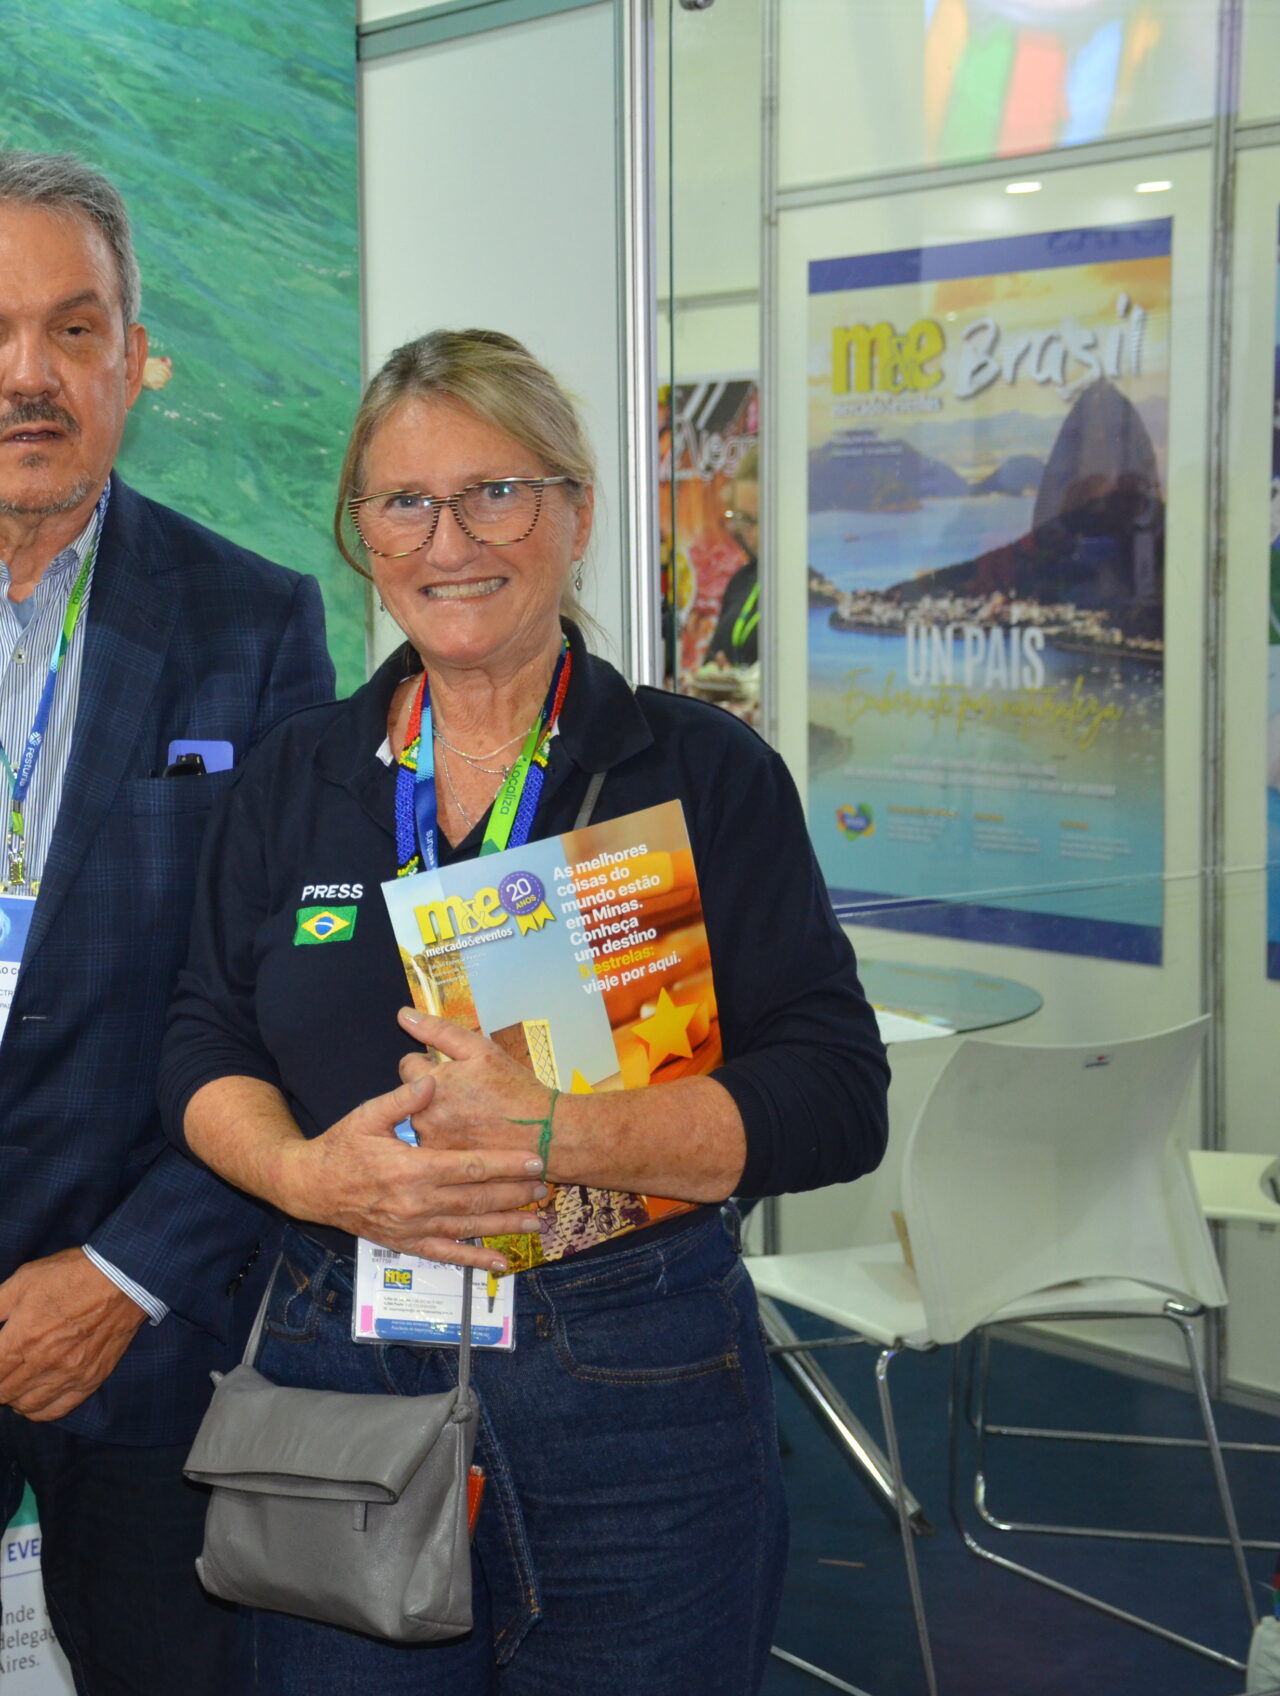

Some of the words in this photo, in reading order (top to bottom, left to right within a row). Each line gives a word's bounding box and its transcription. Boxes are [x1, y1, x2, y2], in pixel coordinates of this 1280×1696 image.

[954, 292, 1148, 404] Brasil
[907, 620, 953, 687] UN
[964, 615, 1046, 691] PAÍS
[500, 763, 522, 816] Localiza
[553, 866, 574, 881] As
[576, 843, 648, 874] melhores
[301, 883, 363, 902] PRESS
[506, 878, 532, 903] 20
[557, 875, 608, 897] coisas
[610, 866, 630, 882] do
[561, 888, 616, 914] mundo
[618, 874, 660, 897] estão
[413, 886, 509, 945] m&e
[515, 894, 537, 909] ANOS
[566, 913, 591, 930] em
[592, 899, 643, 923] Minas.
[426, 927, 513, 958] mercado&eventos
[570, 917, 639, 946] Conheça
[574, 946, 600, 963] um
[602, 928, 657, 955] destino
[578, 964, 591, 979] 5
[592, 946, 655, 975] estrelas:
[583, 974, 619, 995] viaje
[621, 965, 646, 986] por
[648, 950, 681, 974] aqui.
[7, 1537, 41, 1562] EVE
[2, 1605, 35, 1625] nde
[0, 1627, 56, 1650] delegaç
